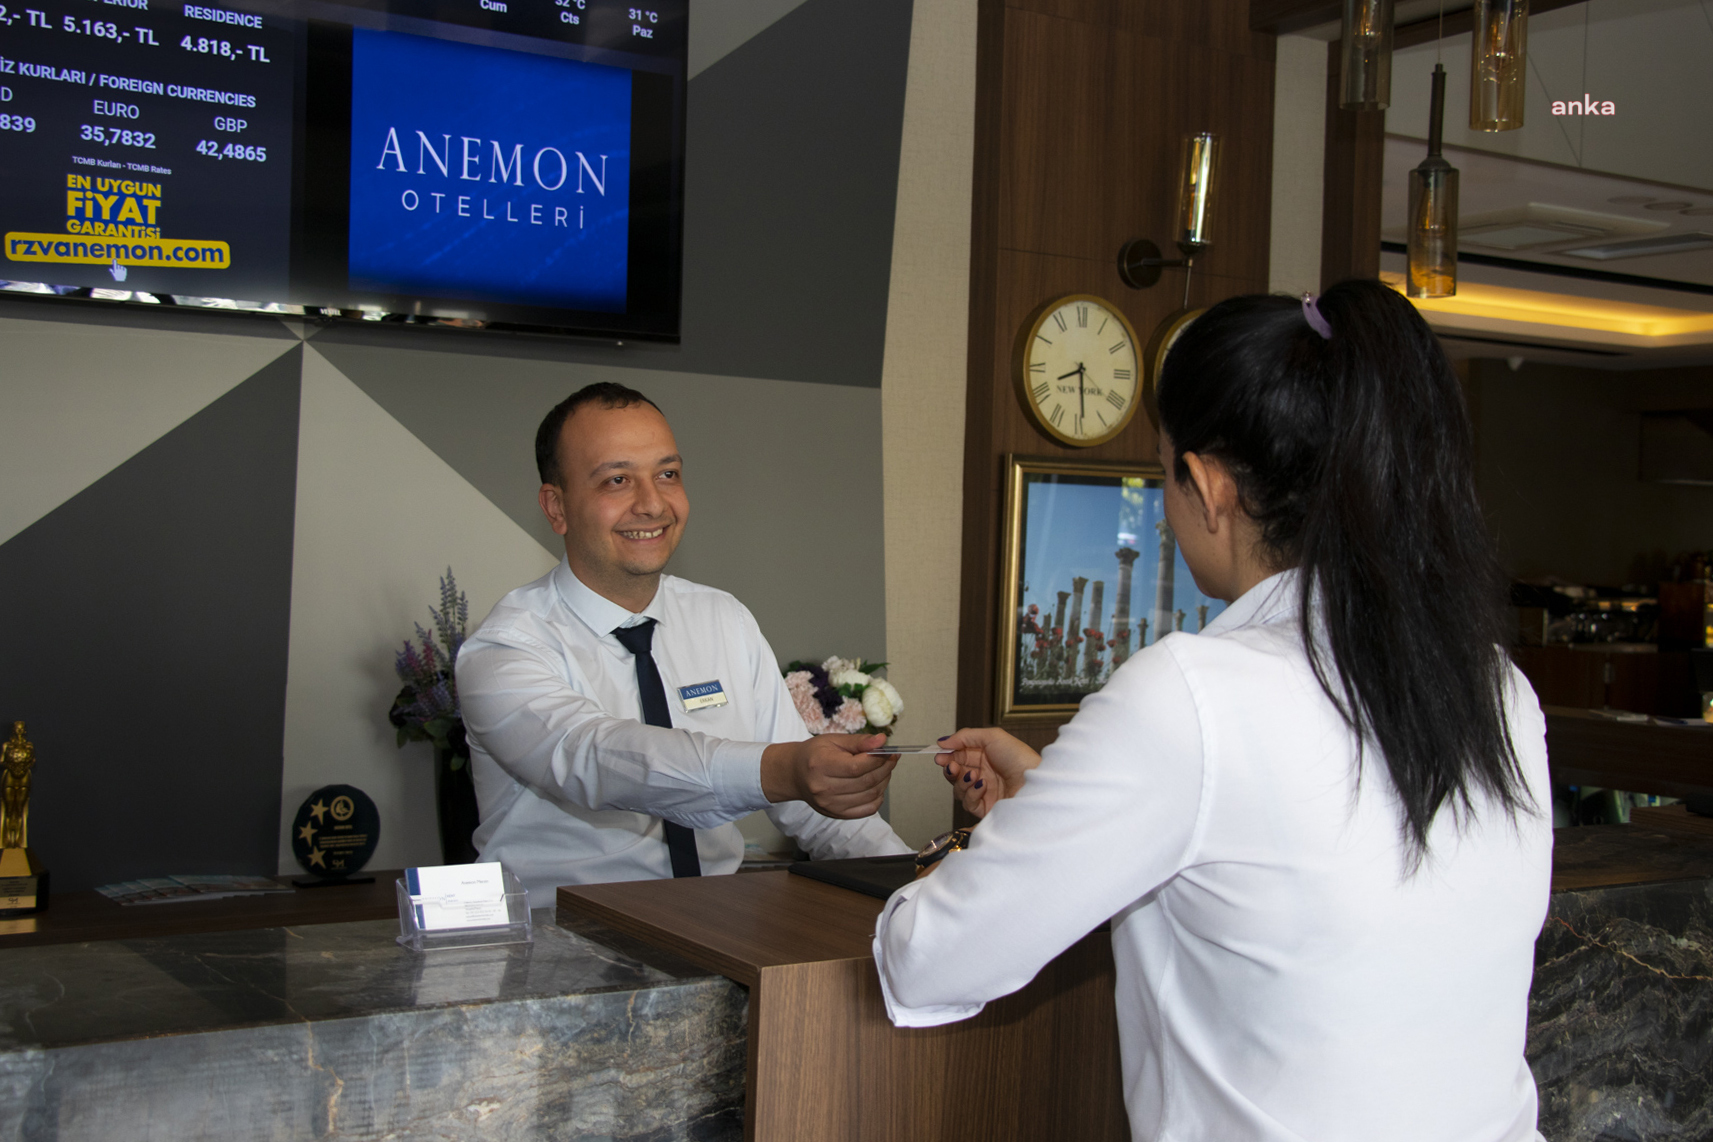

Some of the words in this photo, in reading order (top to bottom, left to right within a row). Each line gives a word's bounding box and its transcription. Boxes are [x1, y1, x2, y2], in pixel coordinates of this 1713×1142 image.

[184, 4, 262, 29] RESIDENCE
[480, 0, 508, 13] Cum
[628, 8, 642, 20] 31
[646, 10, 658, 23] °C
[26, 8, 52, 29] TL
[560, 11, 580, 25] Cts
[134, 26, 160, 46] TL
[632, 24, 653, 38] Paz
[246, 44, 270, 63] TL
[0, 86, 13, 102] D
[18, 62, 86, 84] KURLARI
[88, 73, 96, 86] /
[98, 74, 164, 95] FOREIGN
[166, 84, 256, 108] CURRENCIES
[93, 100, 140, 120] EURO
[214, 116, 248, 133] GBP
[80, 124, 156, 149] 35,7832
[196, 140, 267, 162] 42,4865
[72, 156, 96, 166] TCMB
[127, 162, 150, 172] TCMB
[150, 164, 172, 175] Rates
[376, 126, 608, 197] ANEMON
[66, 174, 92, 190] EN
[96, 177, 162, 198] UYGUN
[402, 189, 584, 230] OTELLERİ
[10, 238, 224, 263] rzvanemon.com
[1056, 385, 1076, 394] NEW
[686, 684, 718, 697] ANEMON
